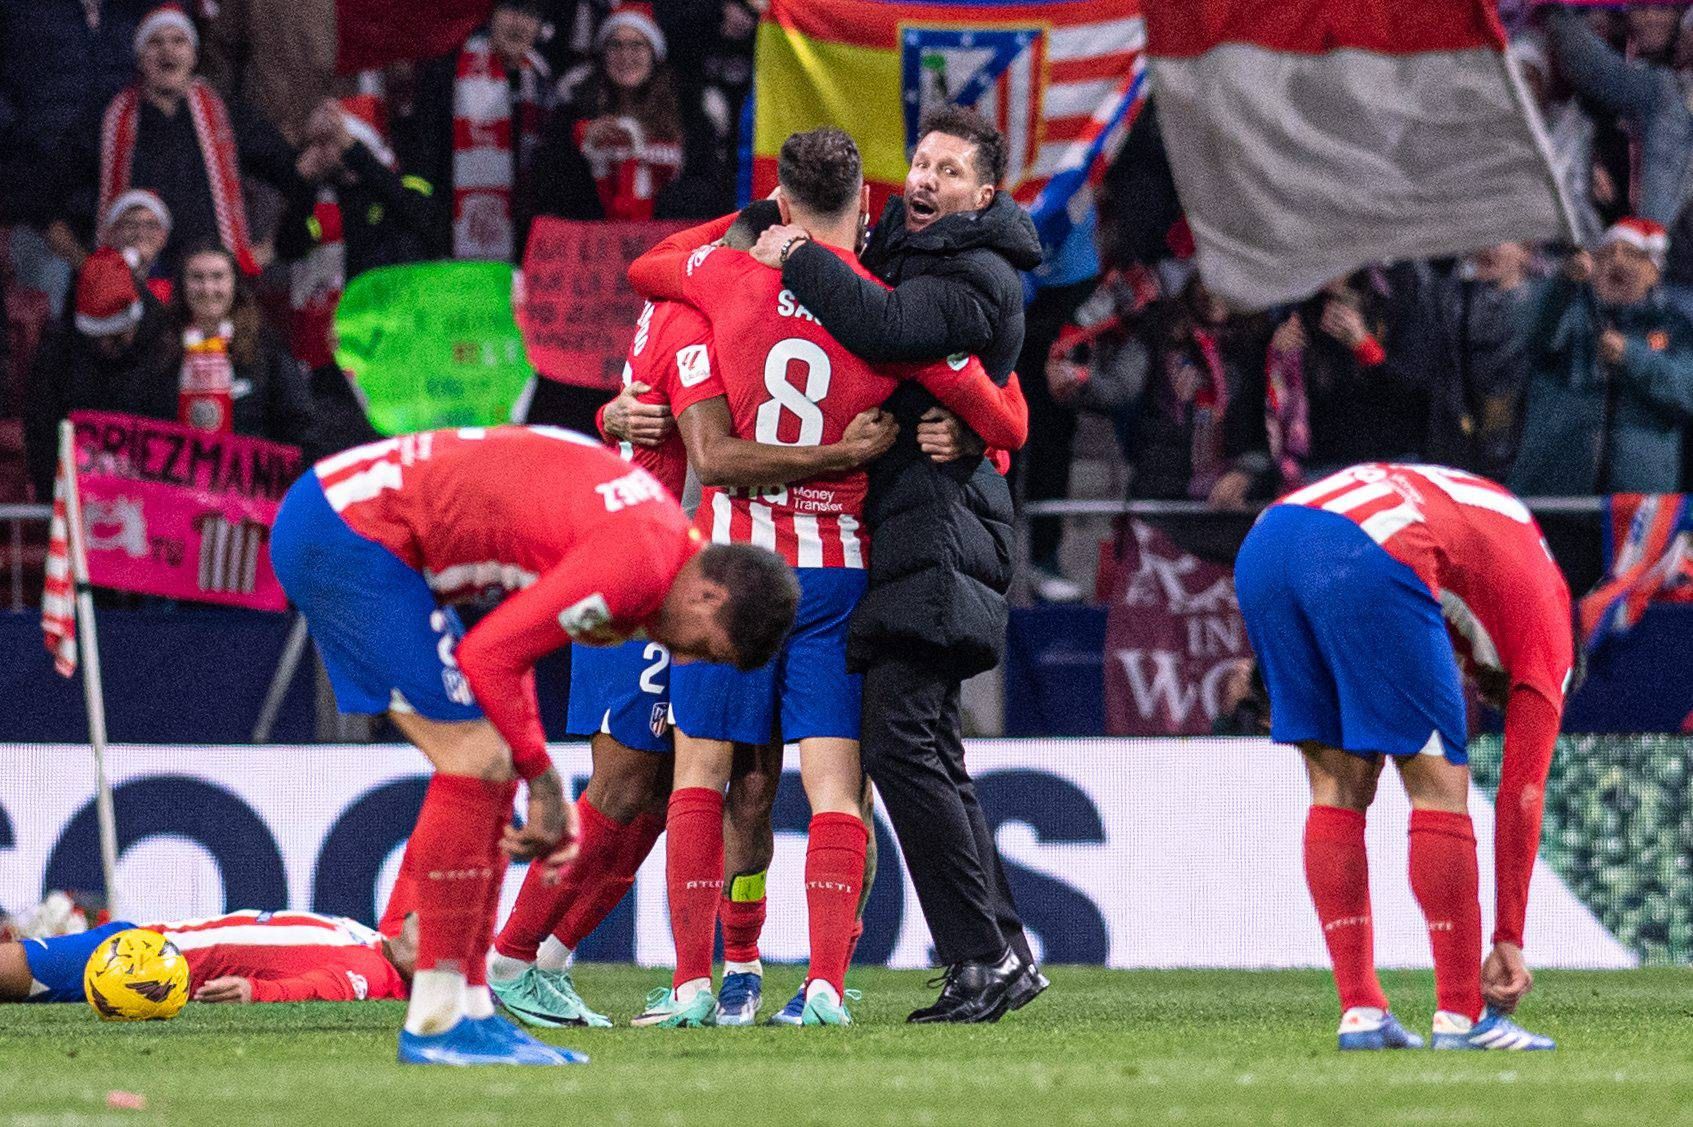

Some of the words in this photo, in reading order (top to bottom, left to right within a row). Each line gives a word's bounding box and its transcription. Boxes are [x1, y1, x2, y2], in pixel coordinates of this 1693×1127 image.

[777, 289, 822, 326] SA
[755, 338, 831, 447] 8
[793, 486, 836, 503] Money
[793, 496, 843, 512] Transfer
[1187, 612, 1244, 656] IN
[639, 641, 670, 694] 2
